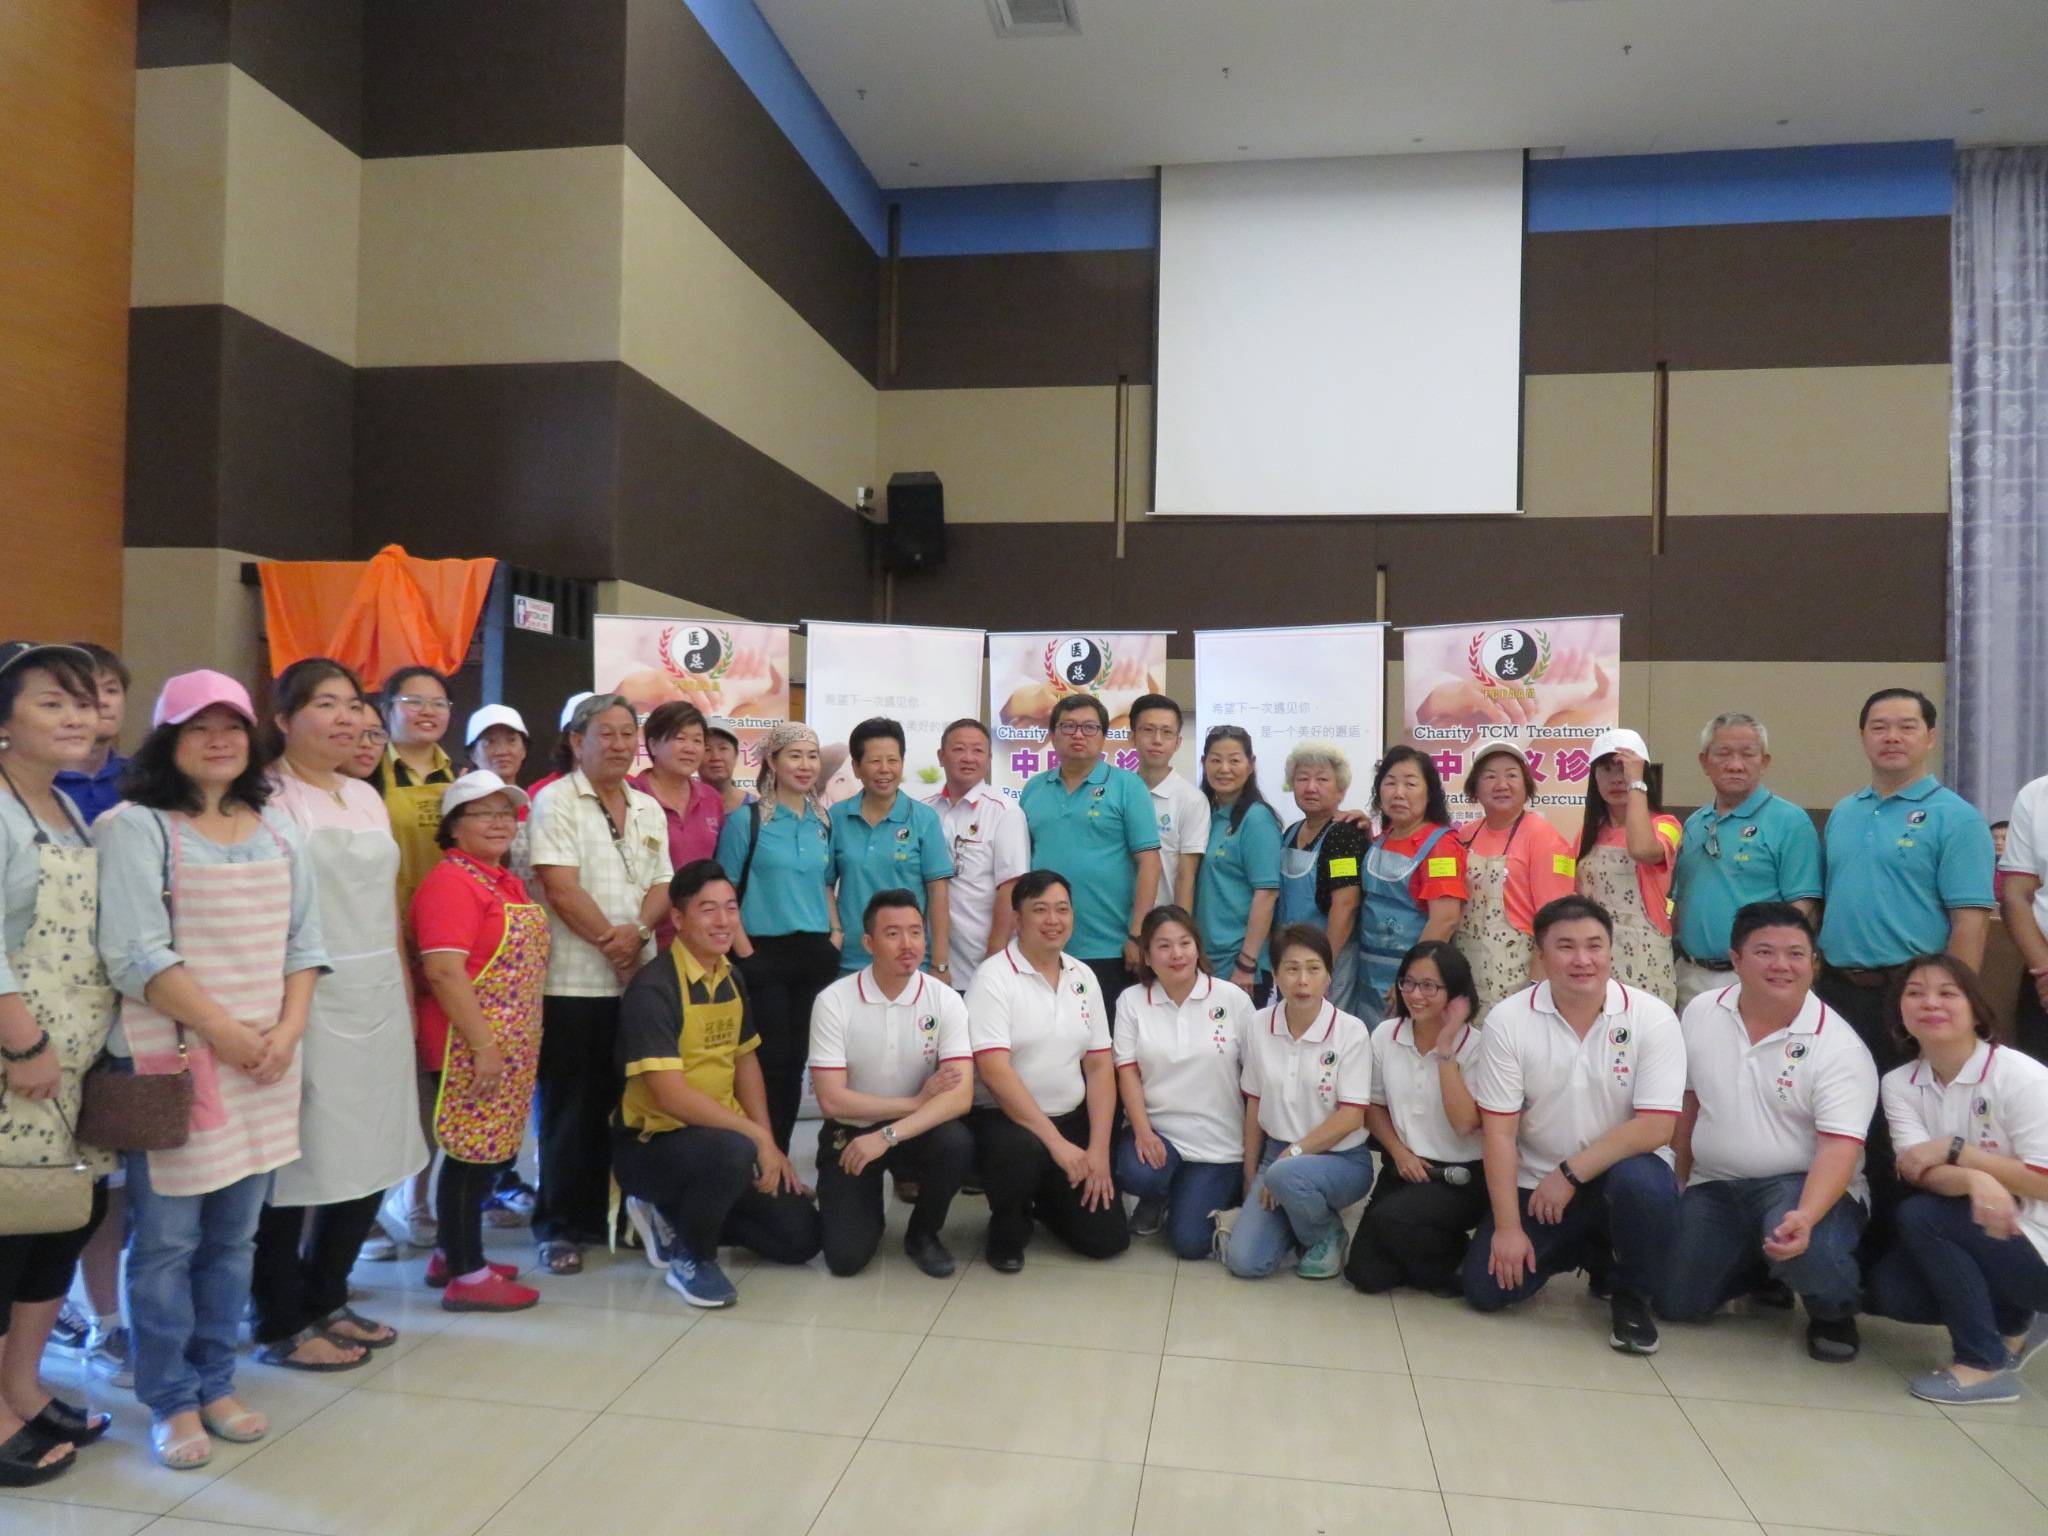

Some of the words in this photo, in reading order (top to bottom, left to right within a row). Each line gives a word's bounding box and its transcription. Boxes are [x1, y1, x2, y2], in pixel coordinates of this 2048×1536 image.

[998, 727, 1048, 742] Charity
[1414, 726, 1471, 741] Charity
[1479, 725, 1519, 738] TCM
